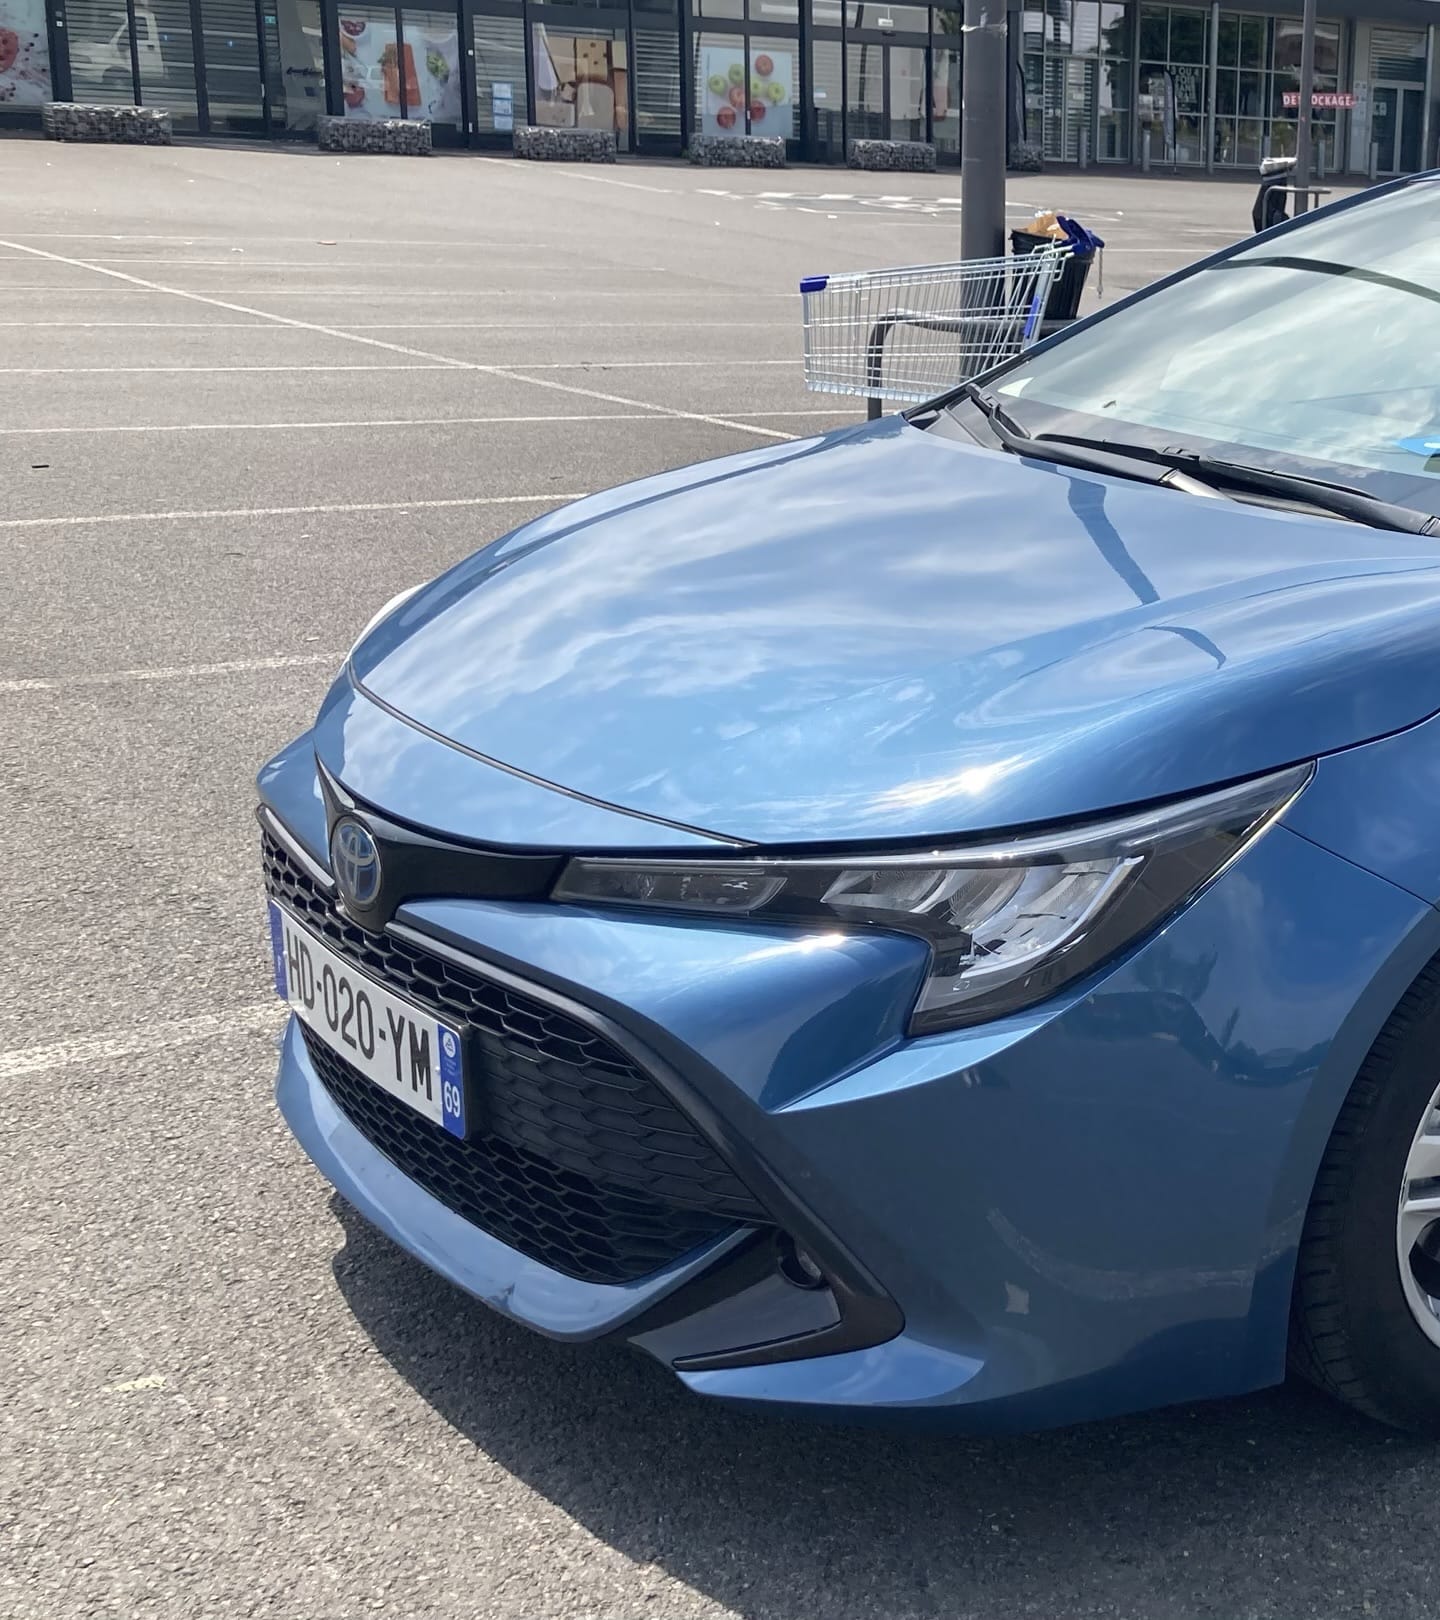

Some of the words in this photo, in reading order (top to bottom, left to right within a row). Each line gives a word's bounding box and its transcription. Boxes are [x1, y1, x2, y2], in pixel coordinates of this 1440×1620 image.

[1283, 94, 1351, 107] DEOCKAGE
[286, 926, 433, 1102] HD-020-YM
[443, 1080, 460, 1119] 69
